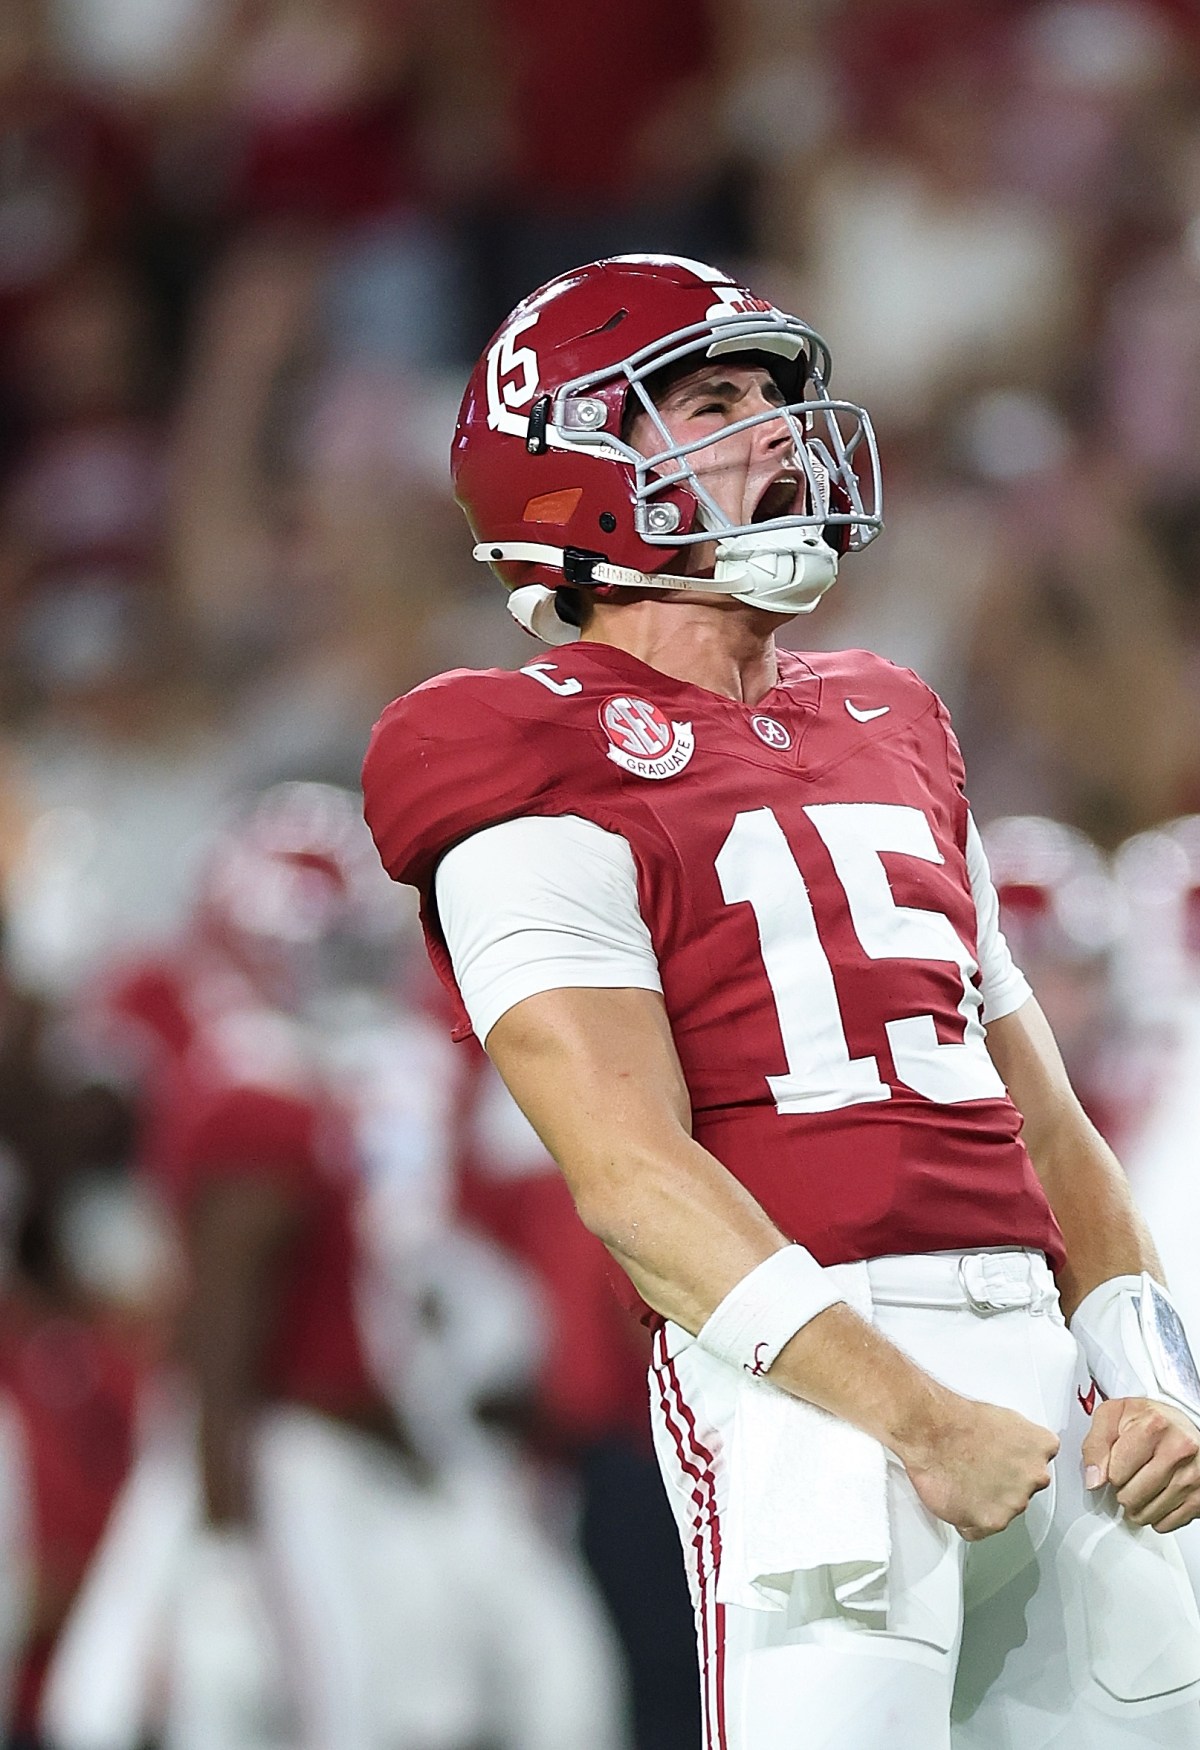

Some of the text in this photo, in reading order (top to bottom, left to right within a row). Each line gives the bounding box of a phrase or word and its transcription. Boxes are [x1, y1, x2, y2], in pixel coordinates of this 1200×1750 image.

[486, 311, 540, 431] 15
[604, 697, 670, 756] SEC
[626, 739, 691, 776] GRADUATE
[714, 802, 1007, 1115] 15
